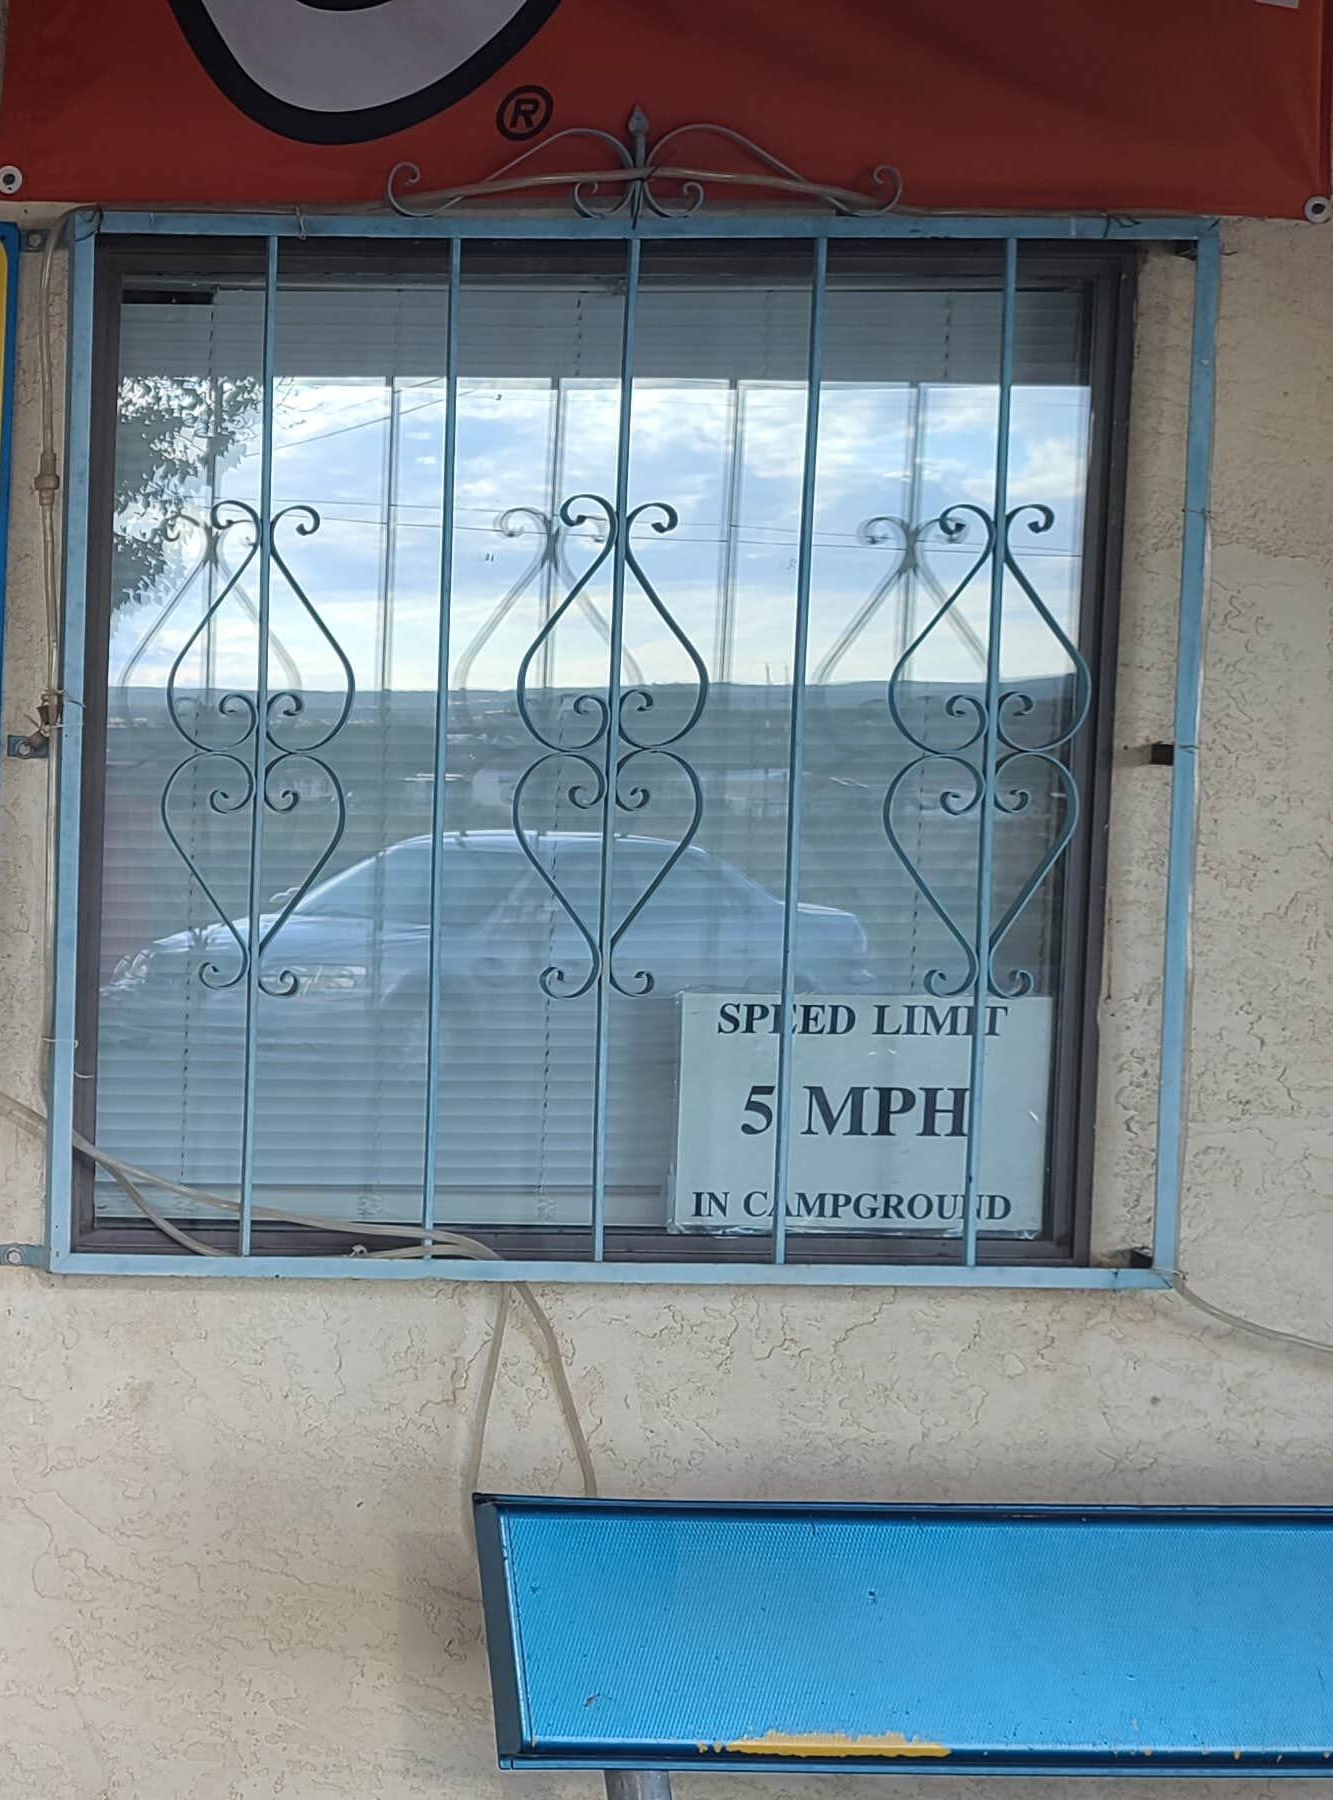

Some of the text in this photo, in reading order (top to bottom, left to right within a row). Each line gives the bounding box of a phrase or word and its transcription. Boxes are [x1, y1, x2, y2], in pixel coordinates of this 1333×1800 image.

[716, 1002, 1009, 1038] SPEED LIMIT
[740, 1085, 970, 1138] 5 MPH
[691, 1190, 731, 1218] IN
